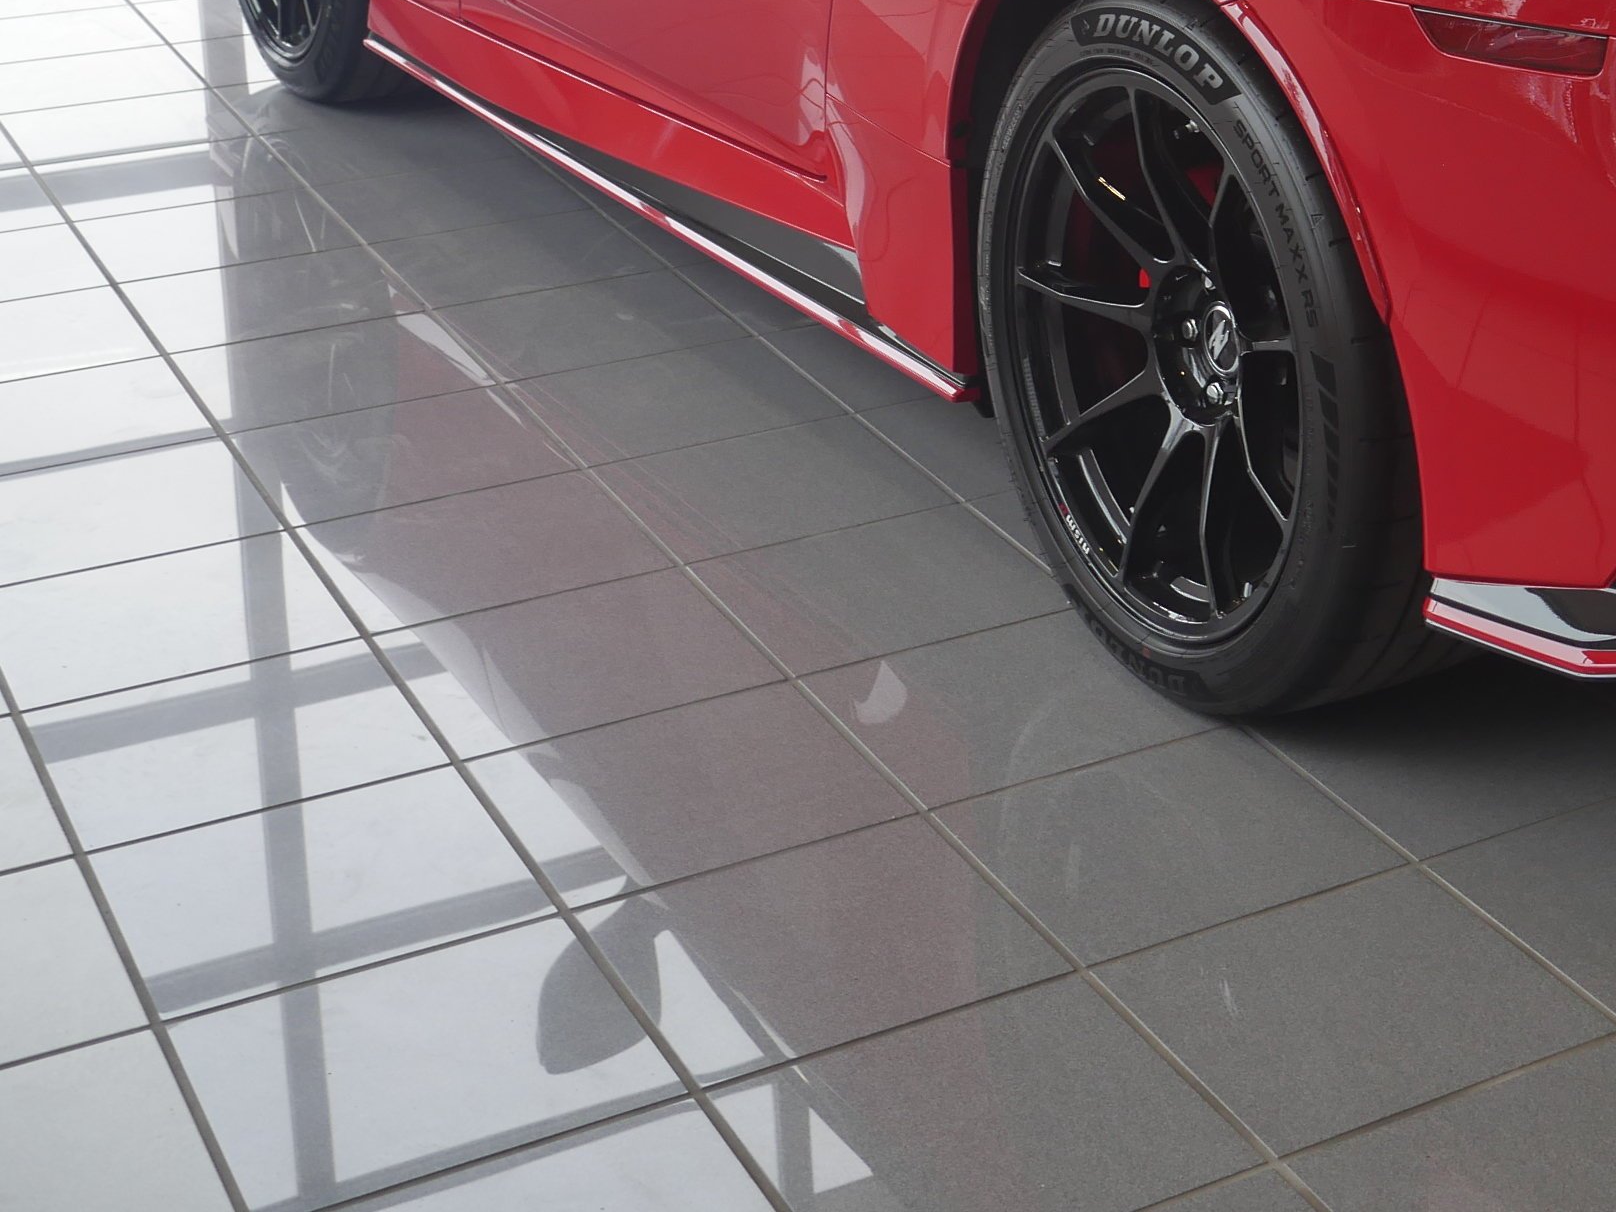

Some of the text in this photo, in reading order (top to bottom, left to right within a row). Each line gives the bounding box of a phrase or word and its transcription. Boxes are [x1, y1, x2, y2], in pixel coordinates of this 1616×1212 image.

[1093, 13, 1224, 89] DUNLOP
[1233, 119, 1280, 198] SPORT
[1275, 202, 1309, 284] MAXX
